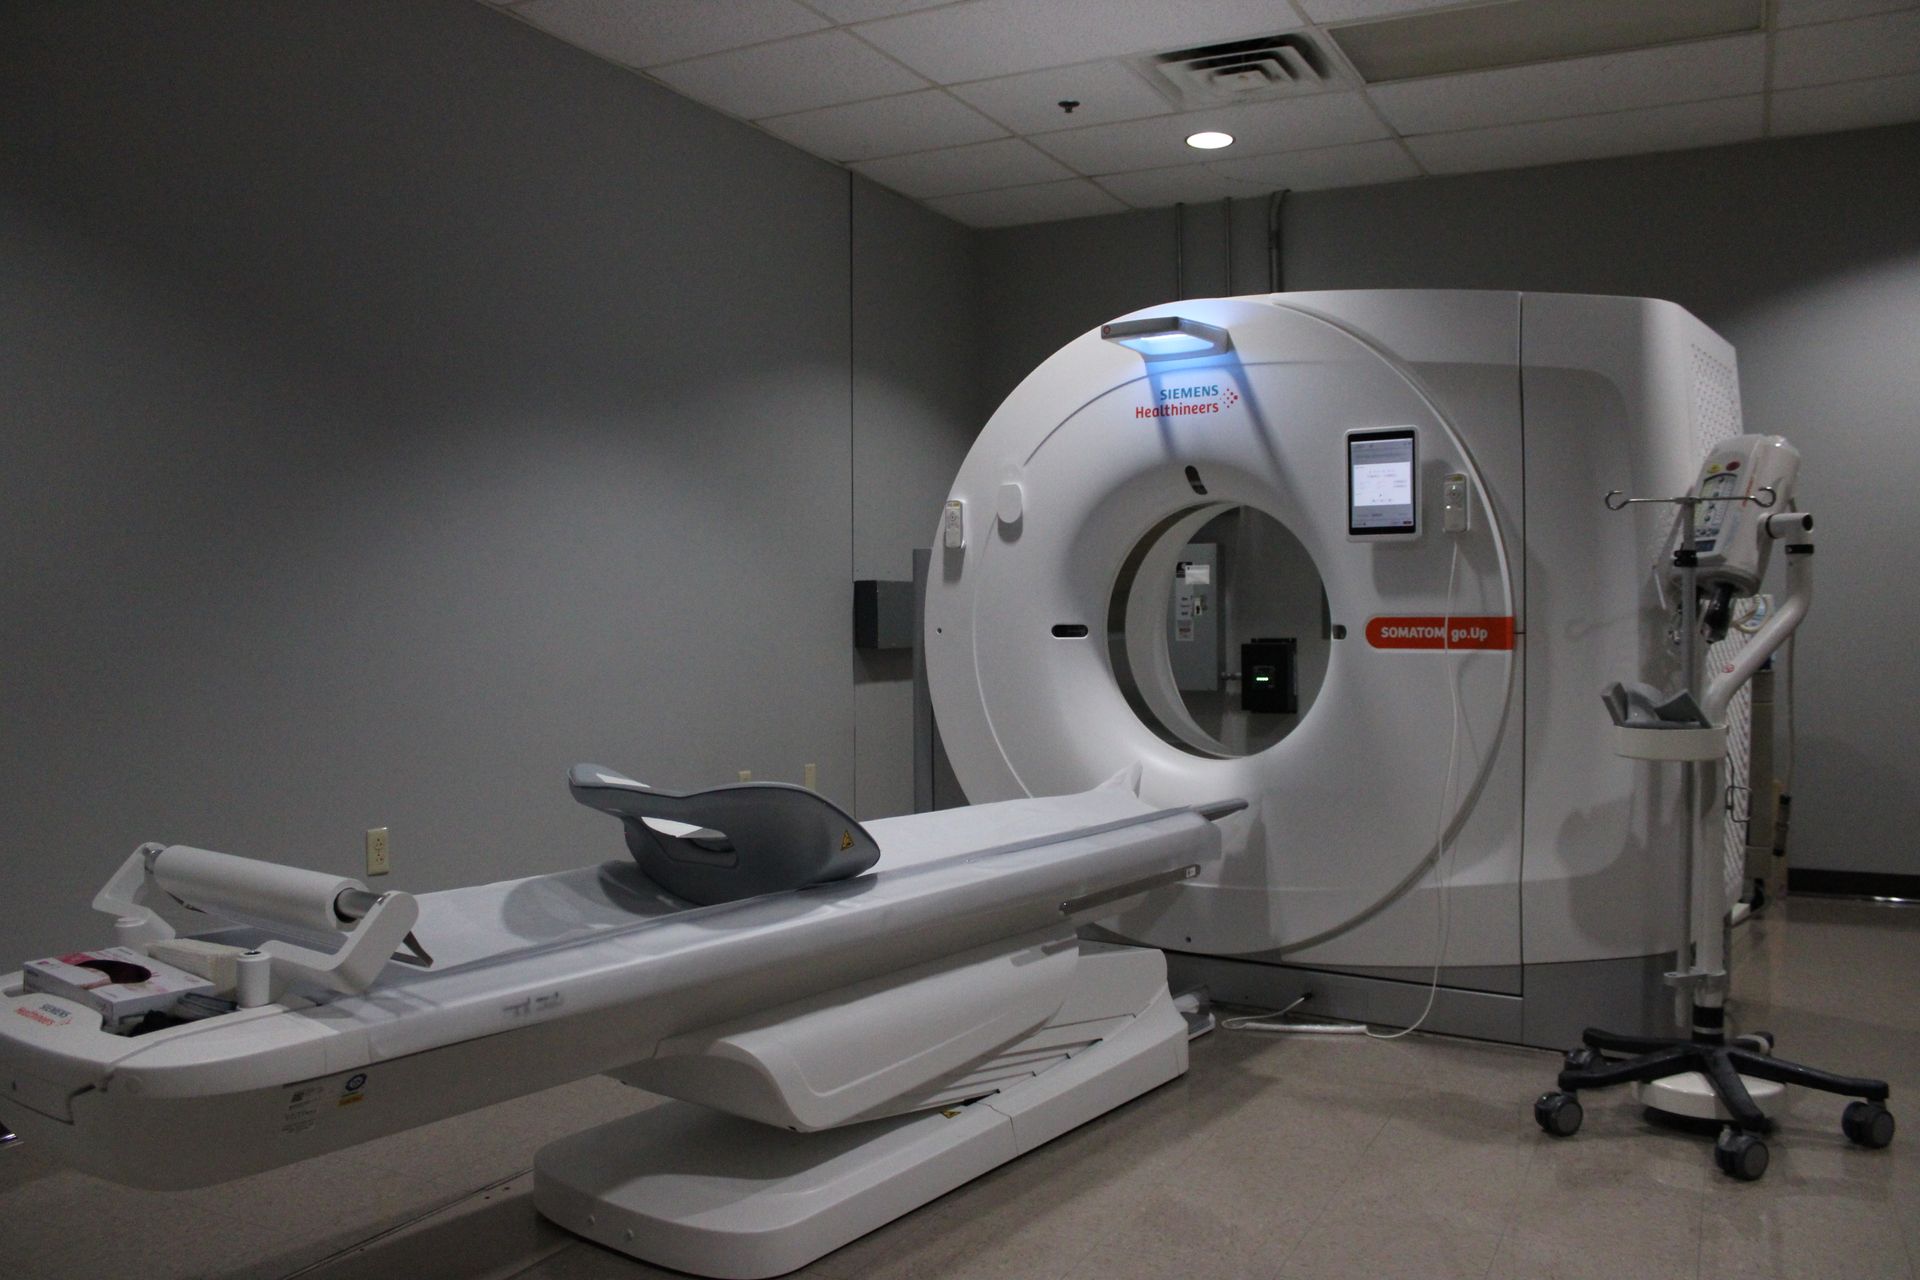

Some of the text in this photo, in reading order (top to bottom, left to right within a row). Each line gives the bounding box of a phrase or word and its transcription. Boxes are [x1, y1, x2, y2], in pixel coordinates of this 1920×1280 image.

[1160, 385, 1219, 400] SIEMENS
[1135, 402, 1219, 418] Healthineers
[1380, 625, 1488, 642] SOMATOM go.Up
